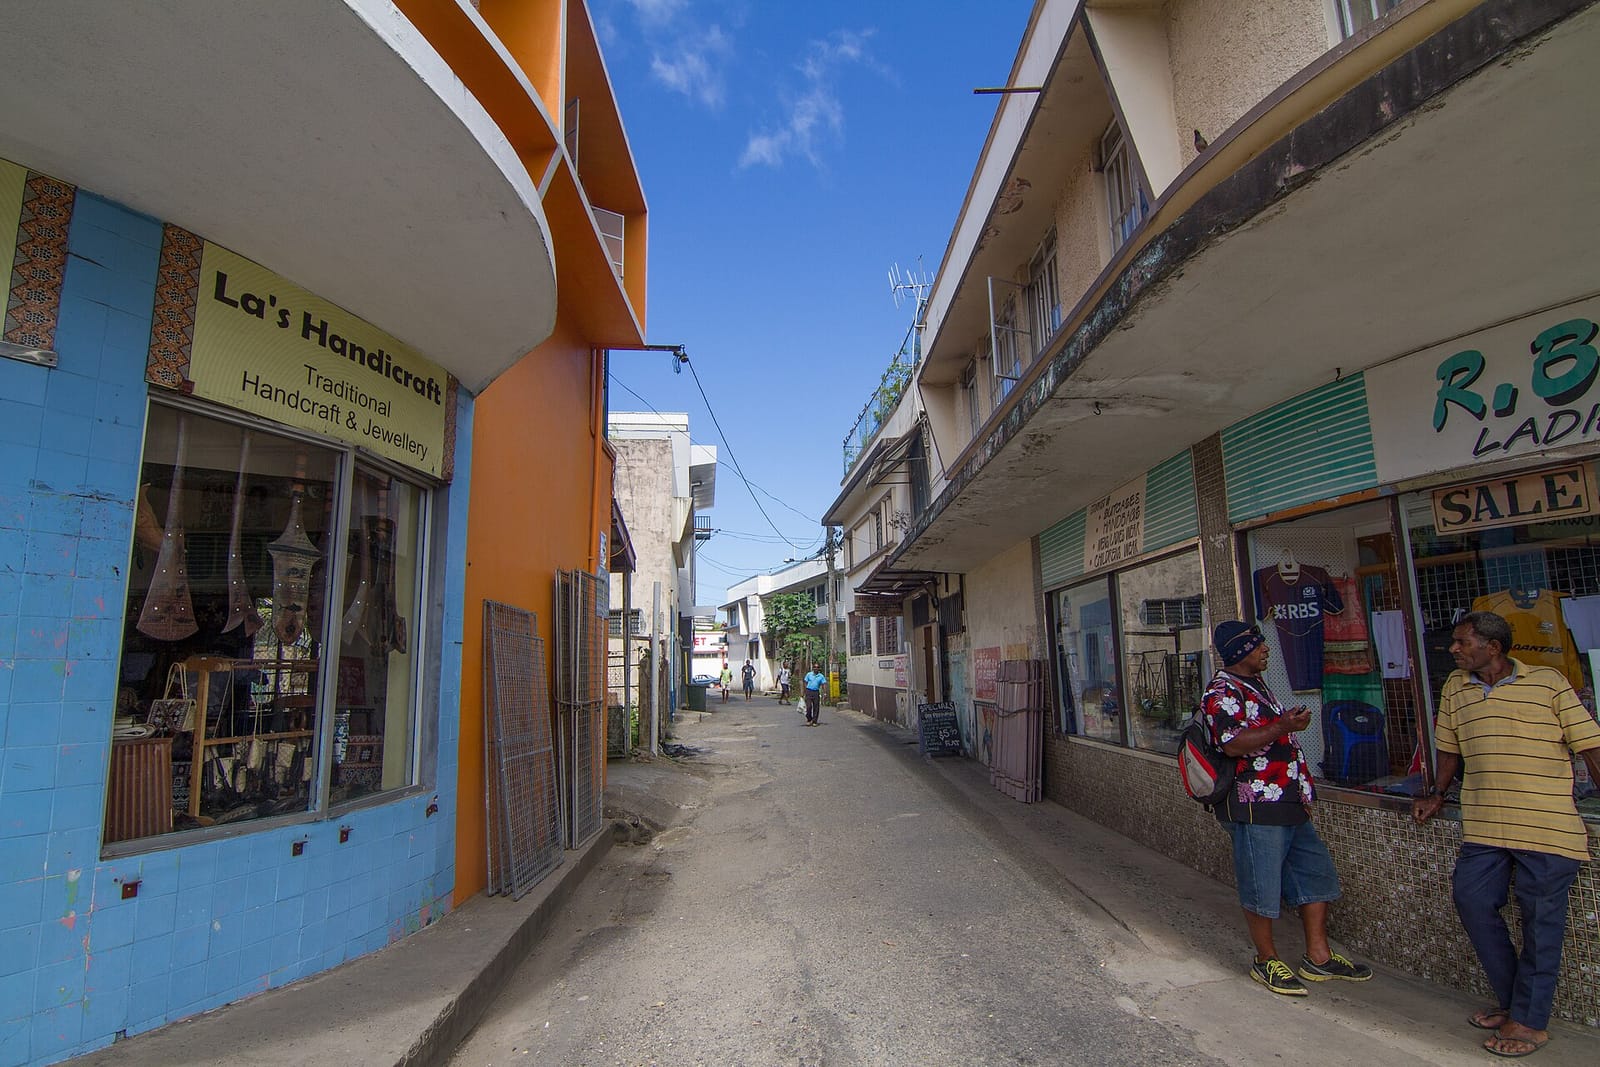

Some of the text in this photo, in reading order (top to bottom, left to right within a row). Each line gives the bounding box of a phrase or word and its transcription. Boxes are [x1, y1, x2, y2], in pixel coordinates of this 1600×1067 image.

[214, 270, 441, 405] La's Handicraft
[304, 364, 391, 418] Traditional
[242, 371, 429, 462] Handcraft & Jewellery
[1441, 470, 1583, 527] SALE
[1103, 505, 1140, 535] HANDBAGS
[1287, 602, 1320, 619] RBS
[1512, 644, 1563, 653] QANTAS
[920, 702, 954, 712] SPECIALS
